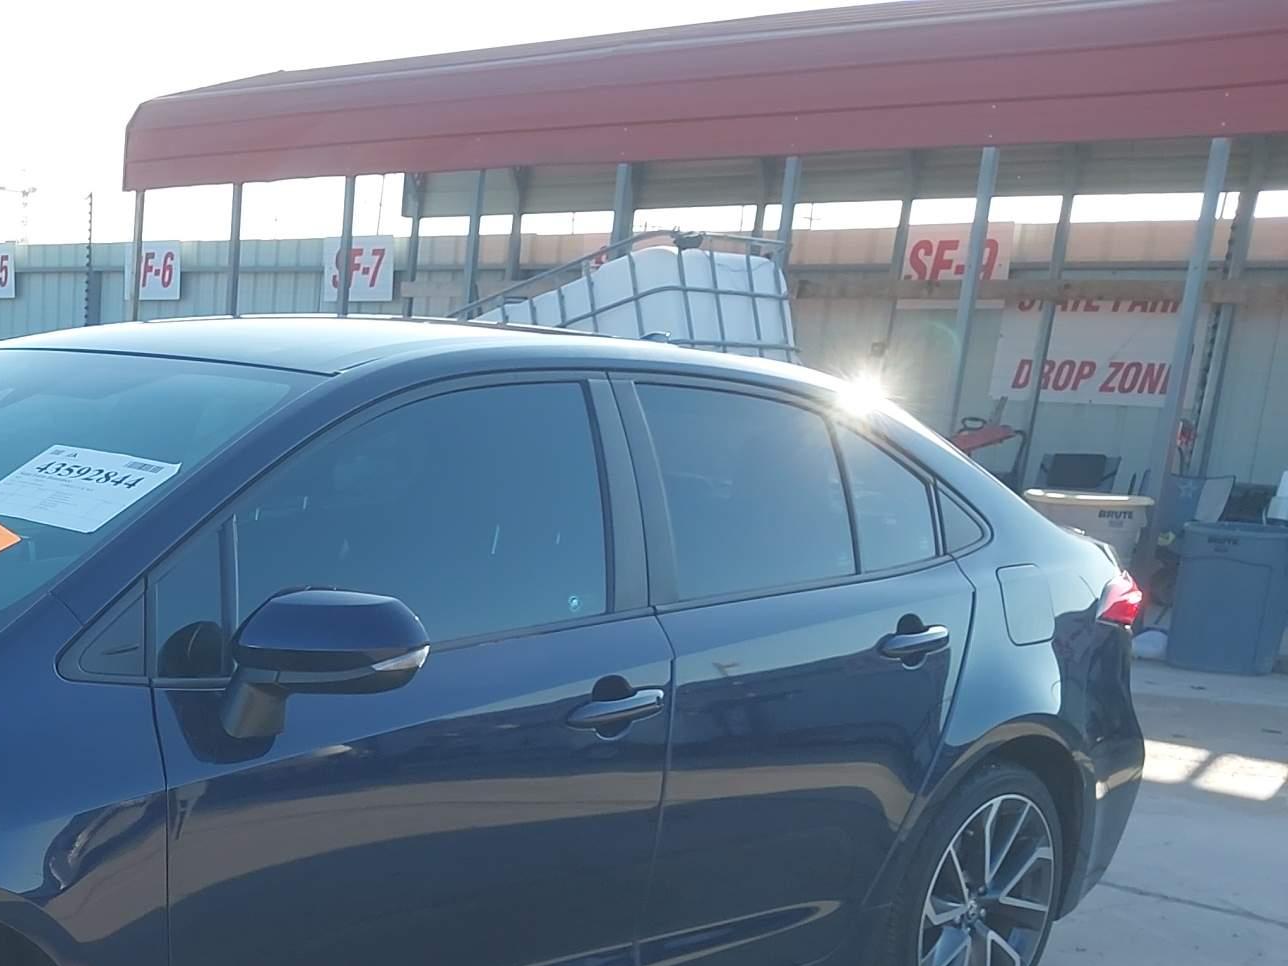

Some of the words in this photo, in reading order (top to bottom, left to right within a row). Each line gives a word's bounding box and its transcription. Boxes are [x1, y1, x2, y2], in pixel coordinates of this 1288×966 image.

[1011, 358, 1097, 391] DROP
[35, 460, 145, 490] 43592844
[1098, 510, 1134, 520] BRUTE
